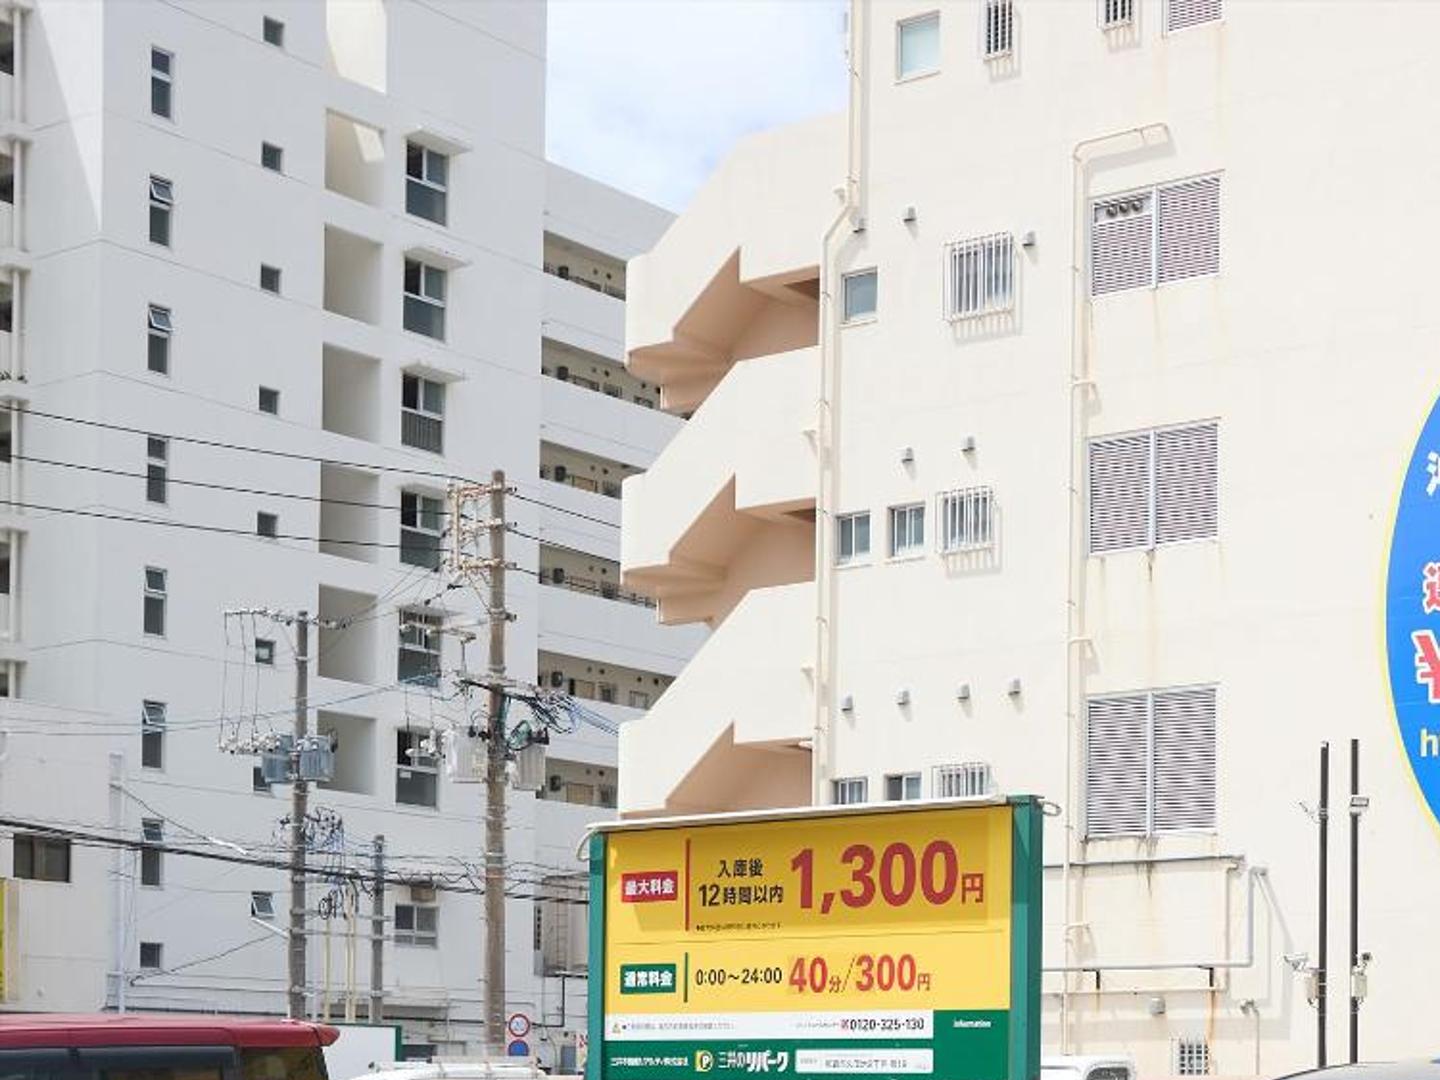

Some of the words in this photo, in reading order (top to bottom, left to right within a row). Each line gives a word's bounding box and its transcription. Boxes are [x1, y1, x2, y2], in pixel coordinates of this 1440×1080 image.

[717, 858, 764, 878] 入庫後
[623, 876, 676, 898] 最大料金
[698, 885, 784, 907] 12時間以内
[624, 970, 674, 989] 通常料金
[718, 1050, 788, 1073] 三井のリパーク
